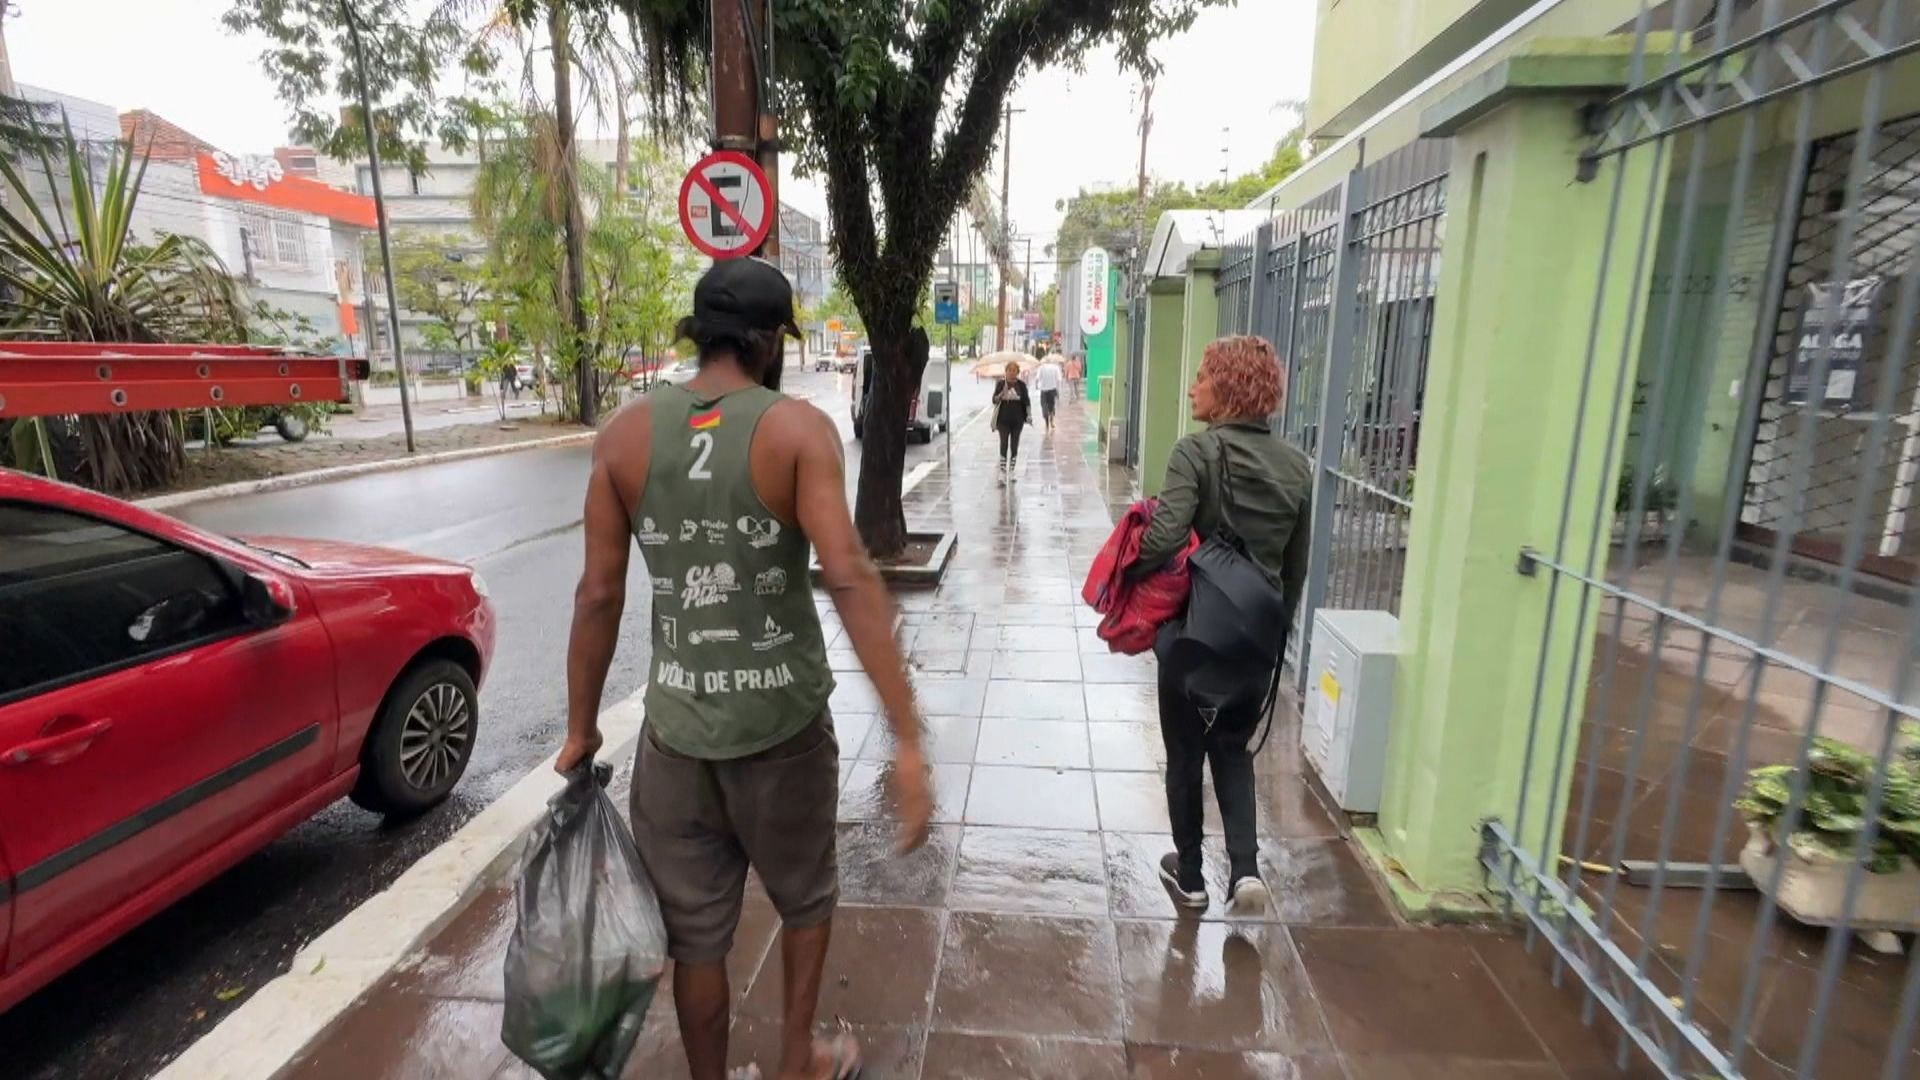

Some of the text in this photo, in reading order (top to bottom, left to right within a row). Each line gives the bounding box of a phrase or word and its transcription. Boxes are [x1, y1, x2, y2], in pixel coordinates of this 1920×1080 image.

[709, 175, 743, 237] E
[1798, 333, 1863, 349] ALGA
[688, 432, 713, 479] 2
[704, 671, 730, 693] DE
[734, 662, 794, 691] PRAIA
